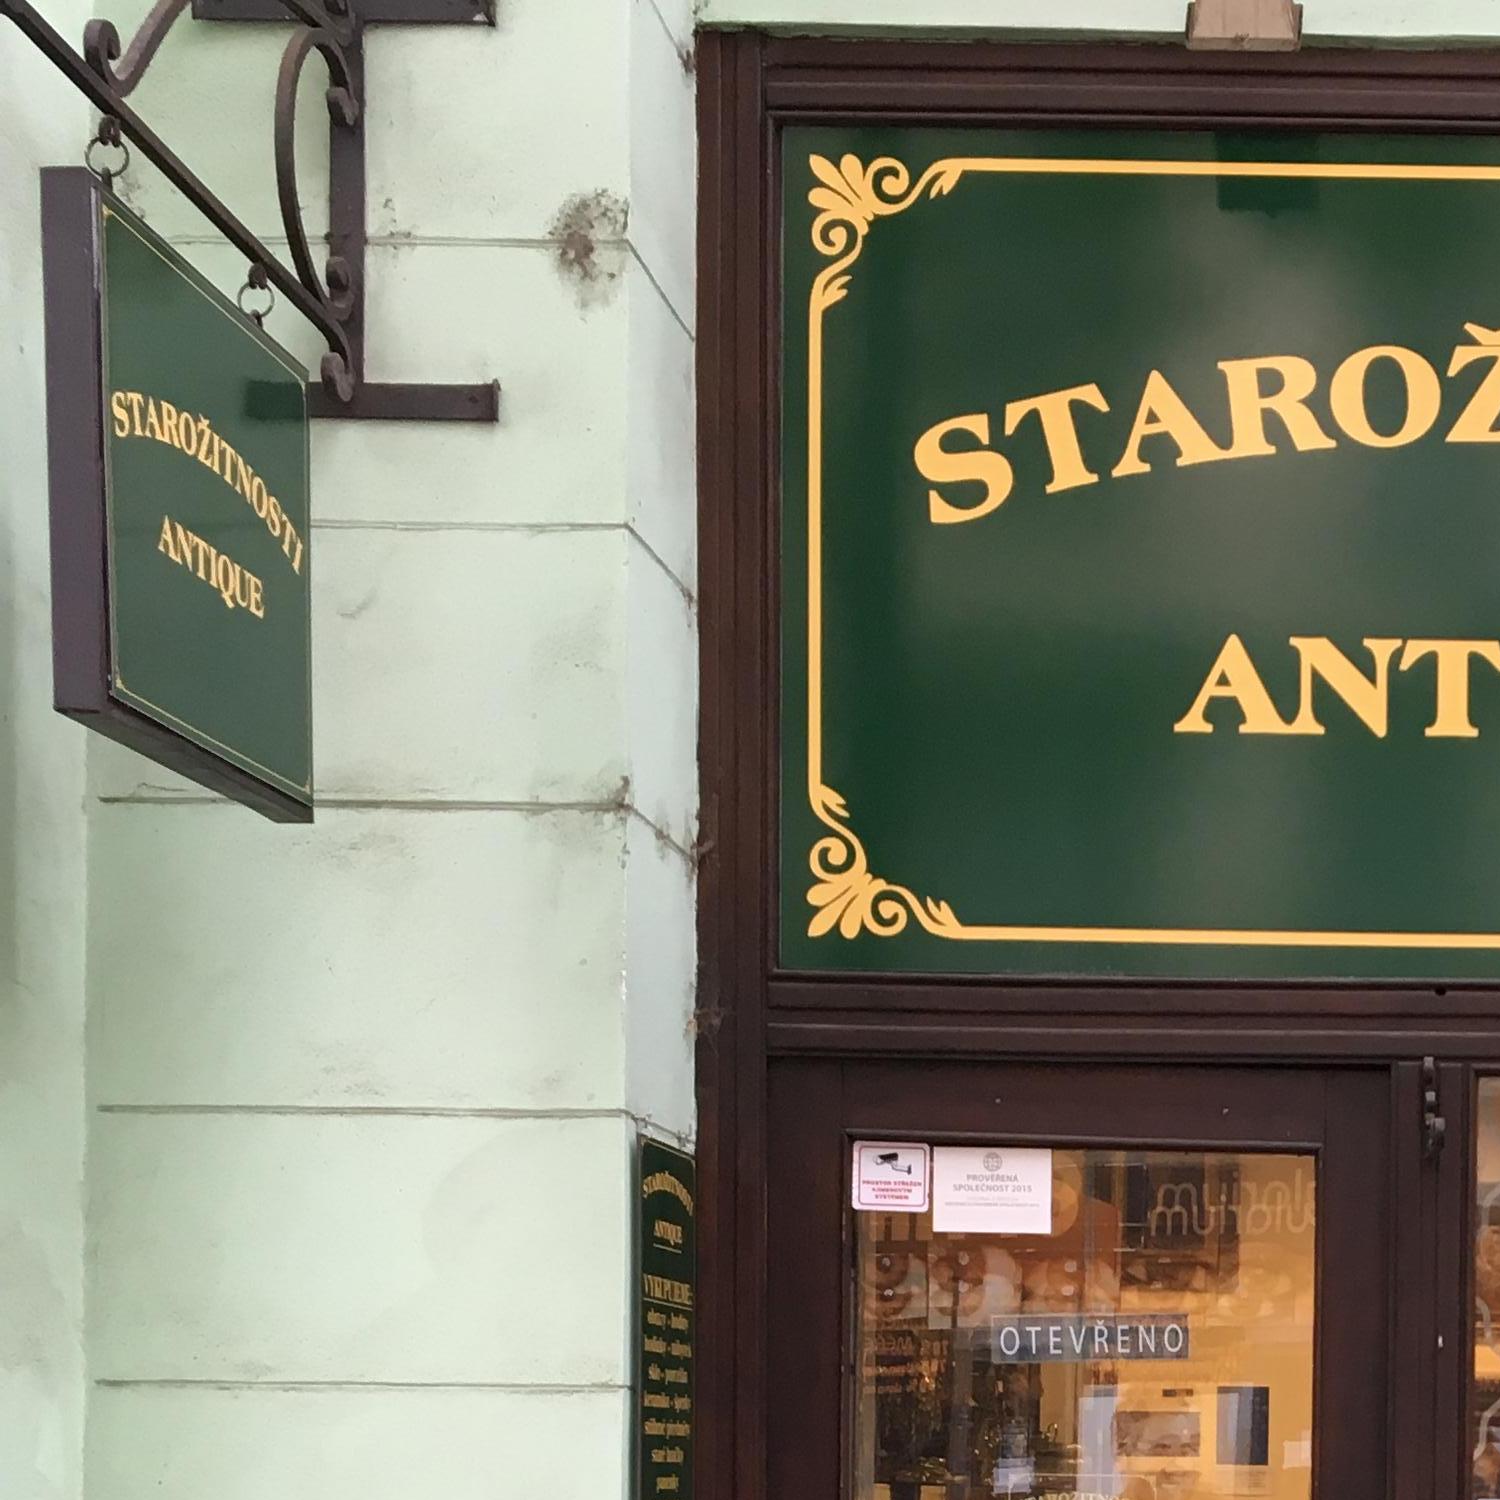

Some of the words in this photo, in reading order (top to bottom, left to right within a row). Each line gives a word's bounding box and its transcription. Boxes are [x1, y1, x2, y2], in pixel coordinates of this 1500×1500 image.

[111, 391, 303, 576] STAROŽITNOSTI
[158, 515, 264, 619] ANTIQUE
[999, 1319, 1184, 1356] OTEVŘENO
